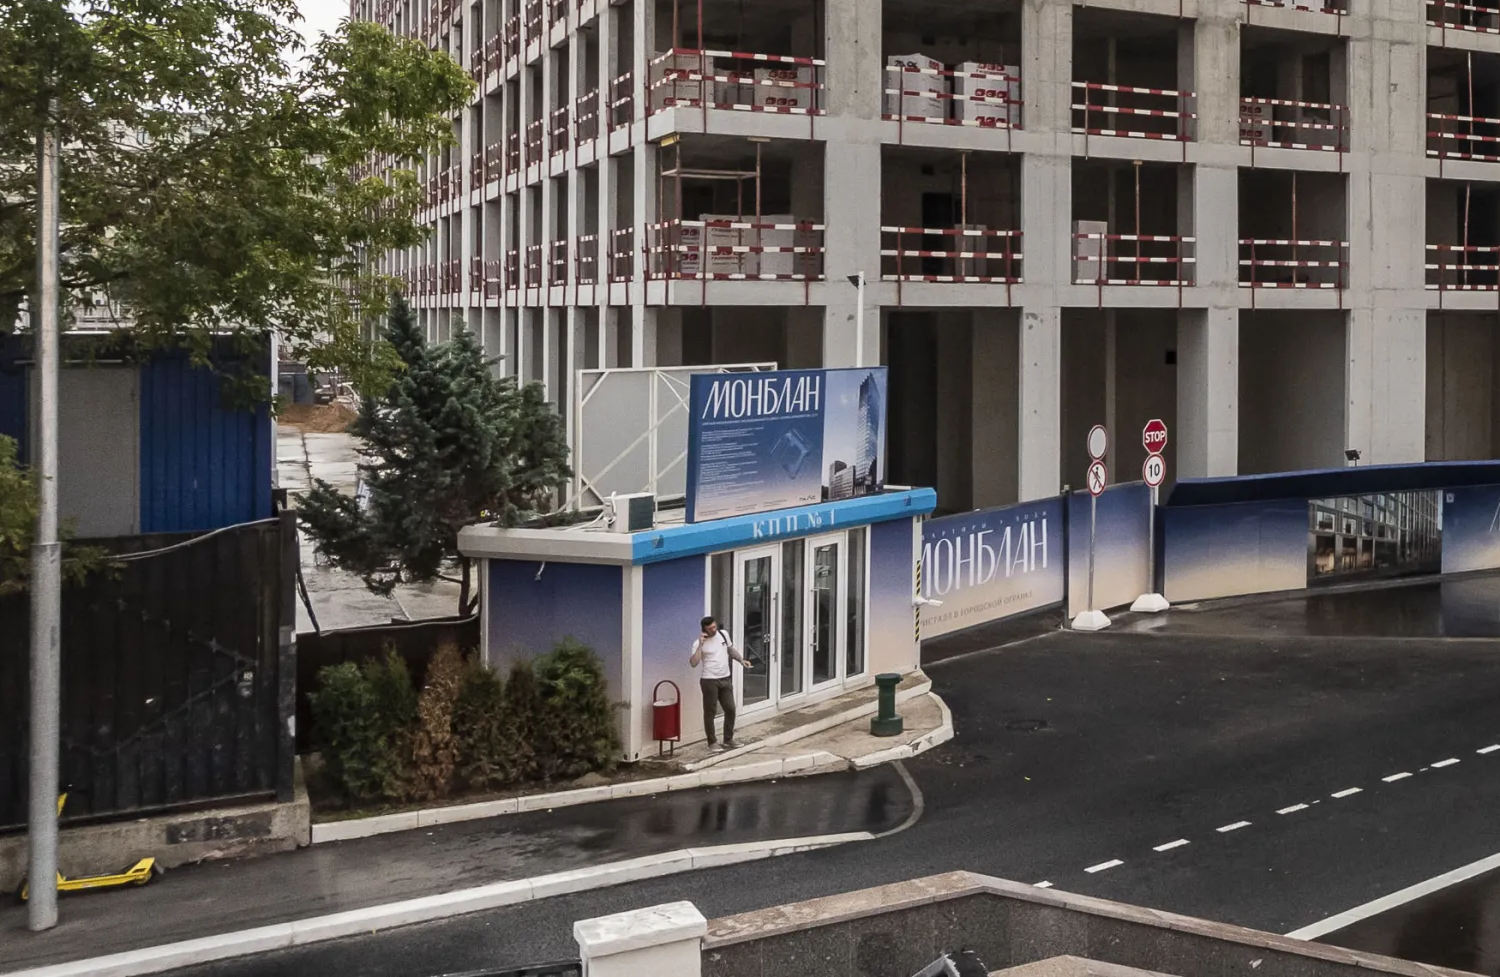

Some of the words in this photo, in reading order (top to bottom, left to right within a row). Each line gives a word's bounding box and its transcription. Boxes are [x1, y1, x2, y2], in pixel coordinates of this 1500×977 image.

[702, 376, 820, 419] МОНБЛАН
[1145, 430, 1165, 443] STOP
[1149, 463, 1160, 477] 10
[753, 514, 798, 538] КПП
[830, 509, 835, 525] 1
